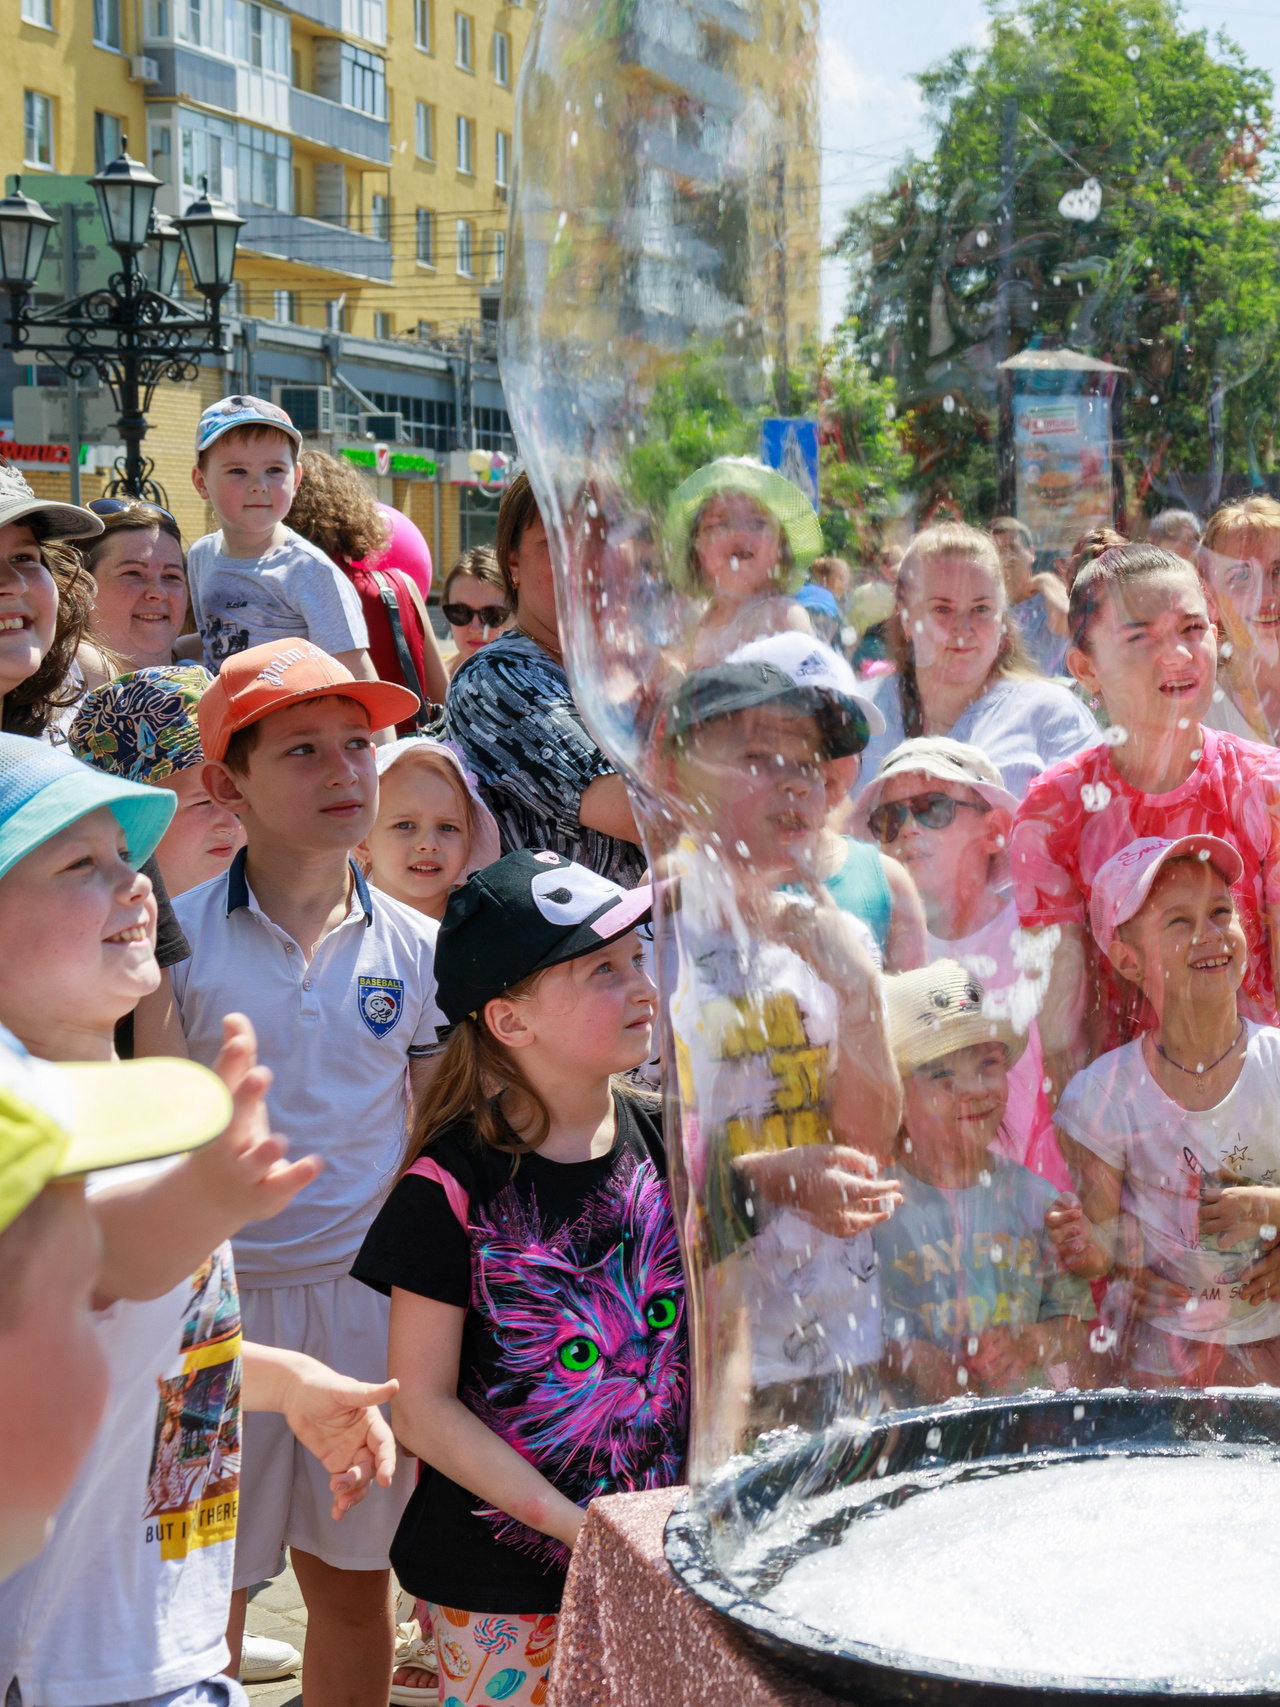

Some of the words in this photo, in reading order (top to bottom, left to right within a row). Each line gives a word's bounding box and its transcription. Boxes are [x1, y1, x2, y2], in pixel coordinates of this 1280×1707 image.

[256, 647, 308, 687] palm
[1117, 840, 1173, 867] Smi
[359, 977, 403, 988] BASEBALL
[893, 1233, 962, 1287] YAY
[973, 1231, 1037, 1277] FOR
[1199, 1287, 1221, 1300] AM
[145, 1522, 175, 1544] BUT
[199, 1500, 238, 1527] THERE
